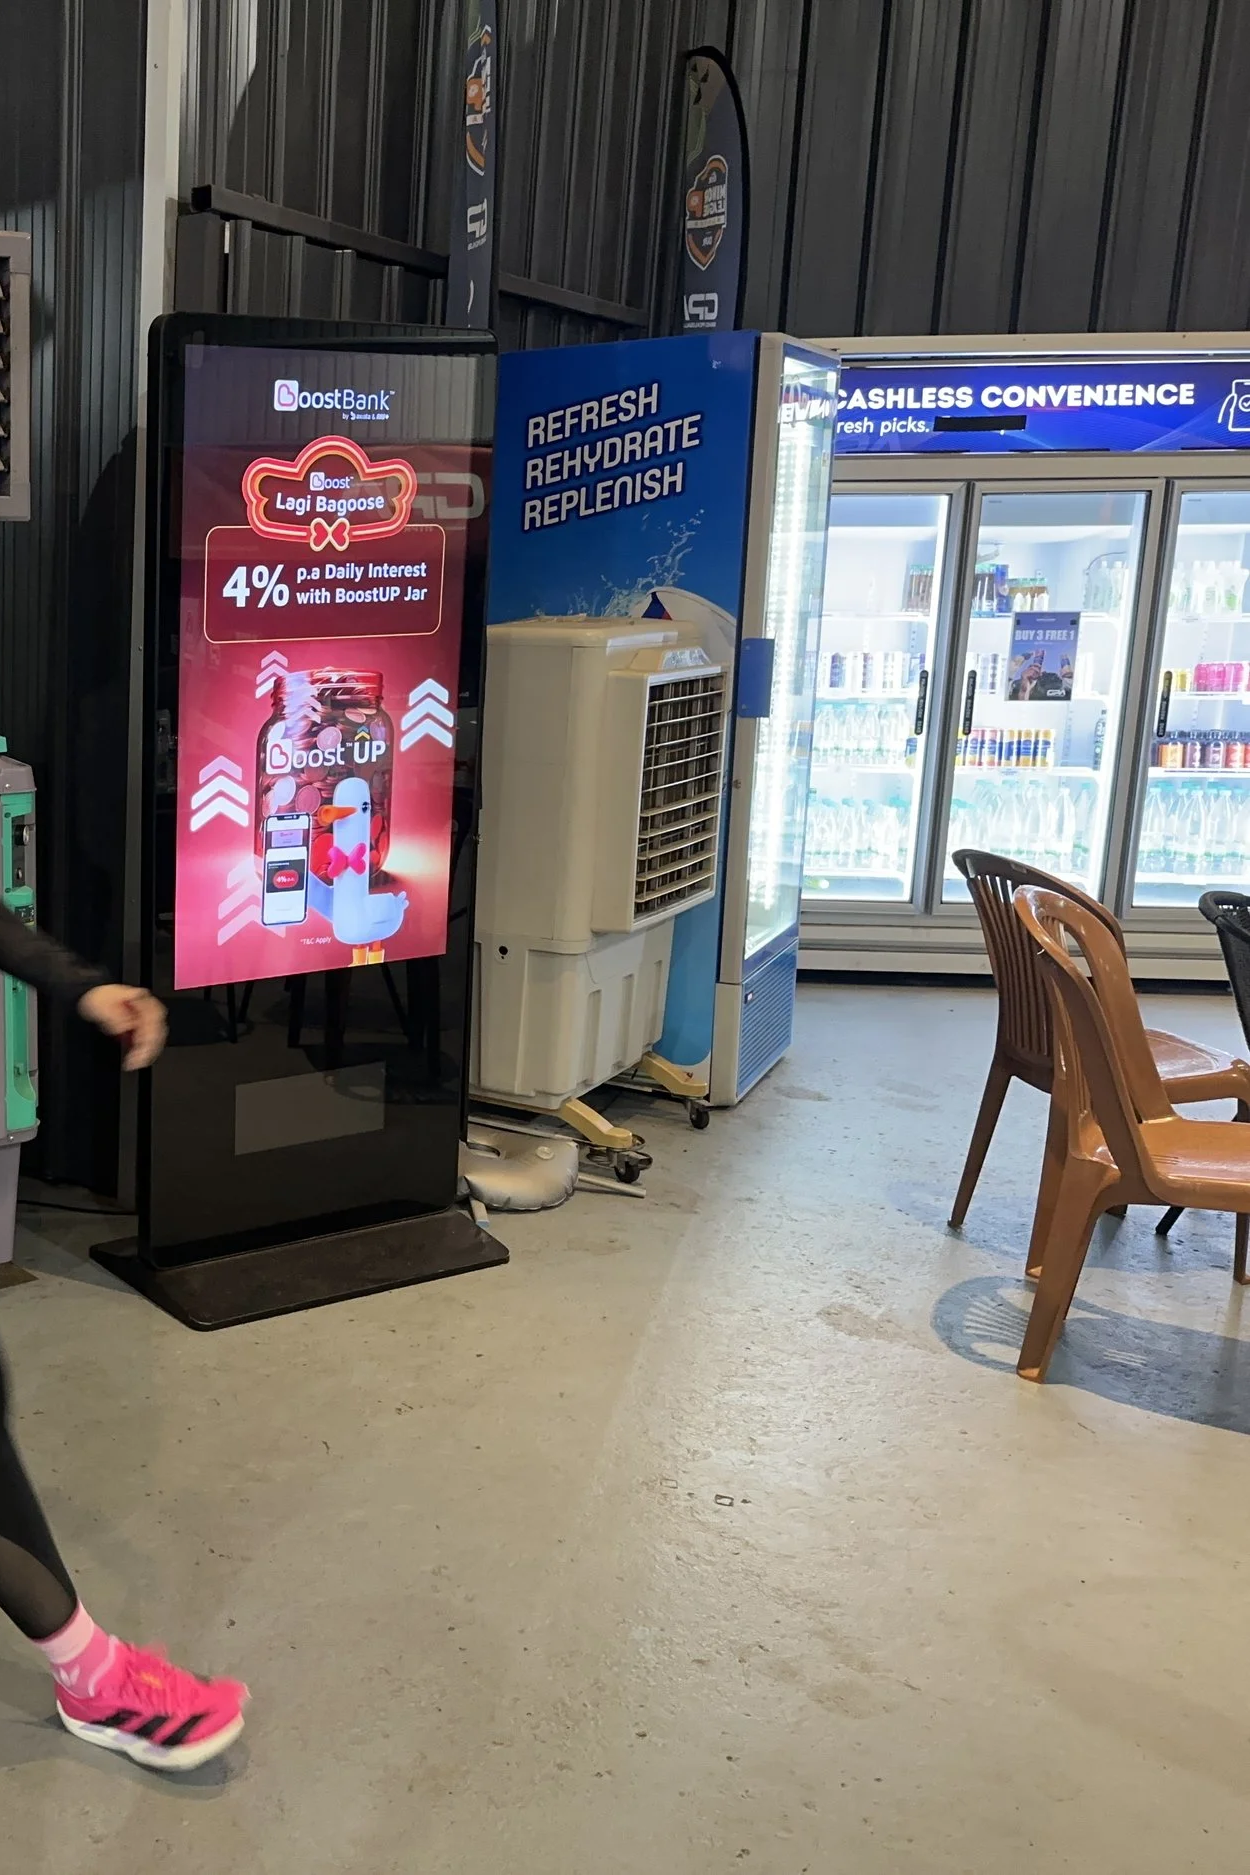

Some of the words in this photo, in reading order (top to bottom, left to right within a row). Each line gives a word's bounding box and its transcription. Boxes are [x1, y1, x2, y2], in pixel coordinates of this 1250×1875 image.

[980, 383, 1195, 408] CONVENIENCE
[527, 383, 659, 448] REFRESH
[836, 416, 874, 434] resh
[879, 415, 930, 437] picks.
[525, 414, 702, 490] REHYDRATE
[275, 492, 311, 515] Lagi
[315, 493, 385, 517] Bagoose
[523, 462, 685, 531] REPLENISH
[296, 566, 320, 584] p.a
[325, 563, 364, 582] Daily
[368, 562, 427, 578] Interest
[222, 564, 290, 608] 4%
[296, 588, 331, 604] with
[335, 586, 401, 603] BoostUP
[404, 585, 428, 601] Jar
[1014, 630, 1036, 641] BUY
[1037, 629, 1044, 641] 3
[1045, 629, 1069, 641] FREE
[1069, 629, 1075, 640] 1
[353, 740, 387, 764] UP
[316, 936, 332, 945] Apply
